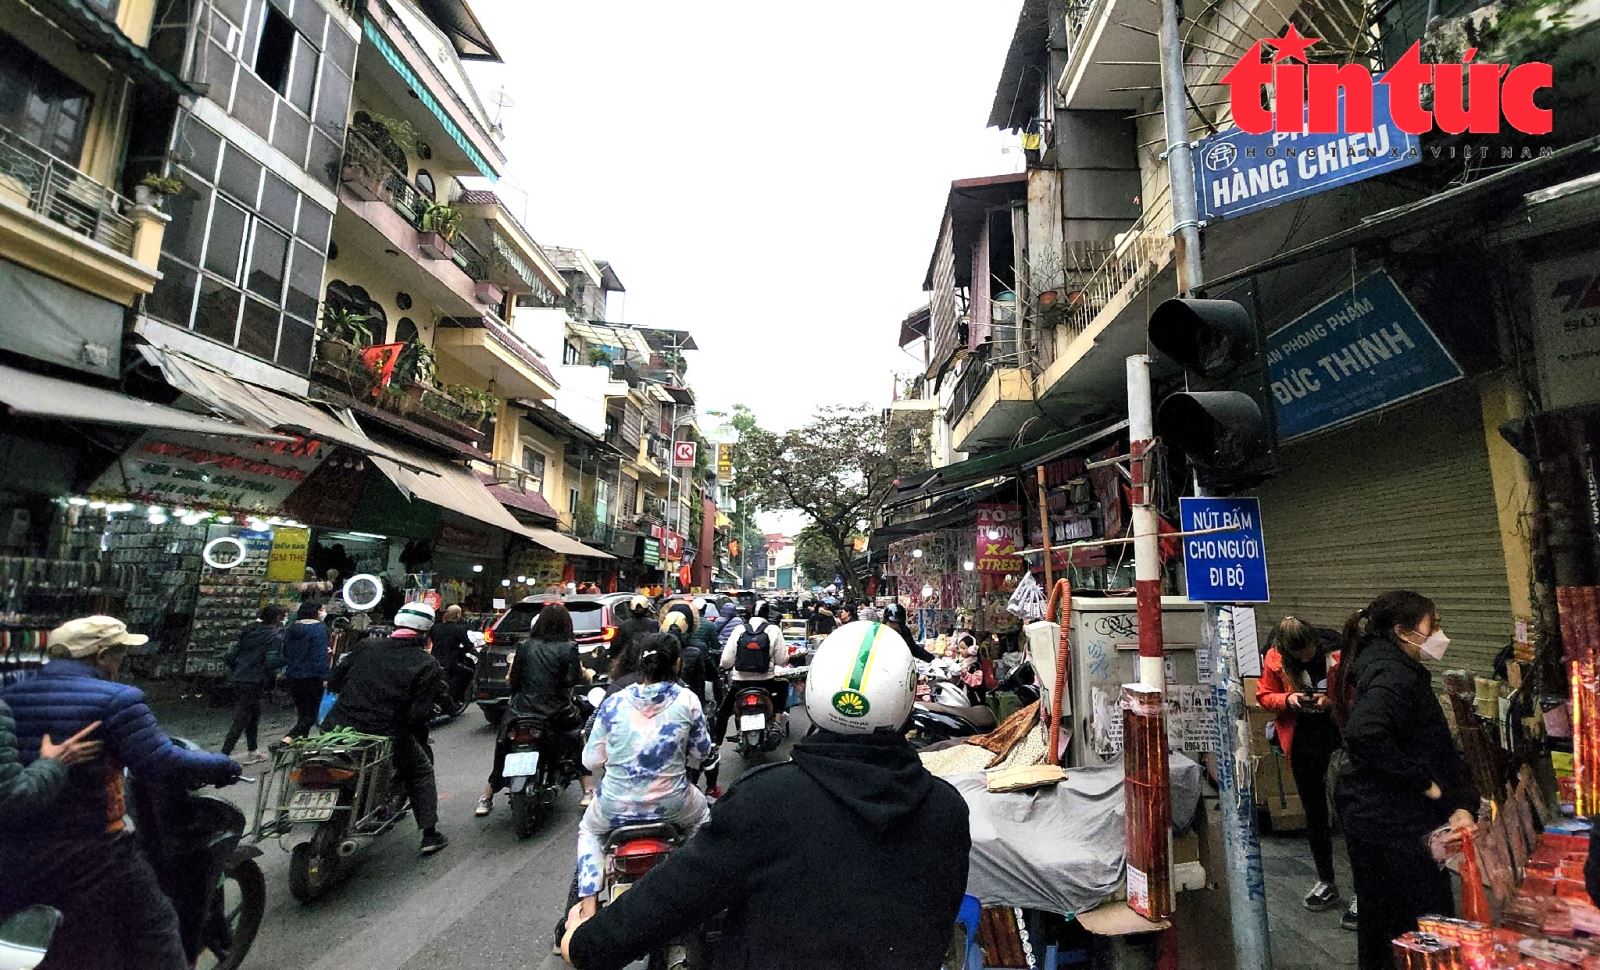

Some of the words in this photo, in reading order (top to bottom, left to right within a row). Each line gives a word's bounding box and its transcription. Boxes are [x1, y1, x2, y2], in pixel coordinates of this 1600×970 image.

[1213, 158, 1290, 208] HÀNG
[1317, 321, 1416, 382] THỊNH
[1193, 507, 1220, 530] NÚT
[1222, 506, 1253, 530] BẤM
[1189, 540, 1217, 560] CHO
[1217, 534, 1260, 559] NGƯỜI
[977, 558, 1022, 571] STRESS
[1209, 567, 1224, 587] ĐI
[1226, 563, 1246, 591] BỘ
